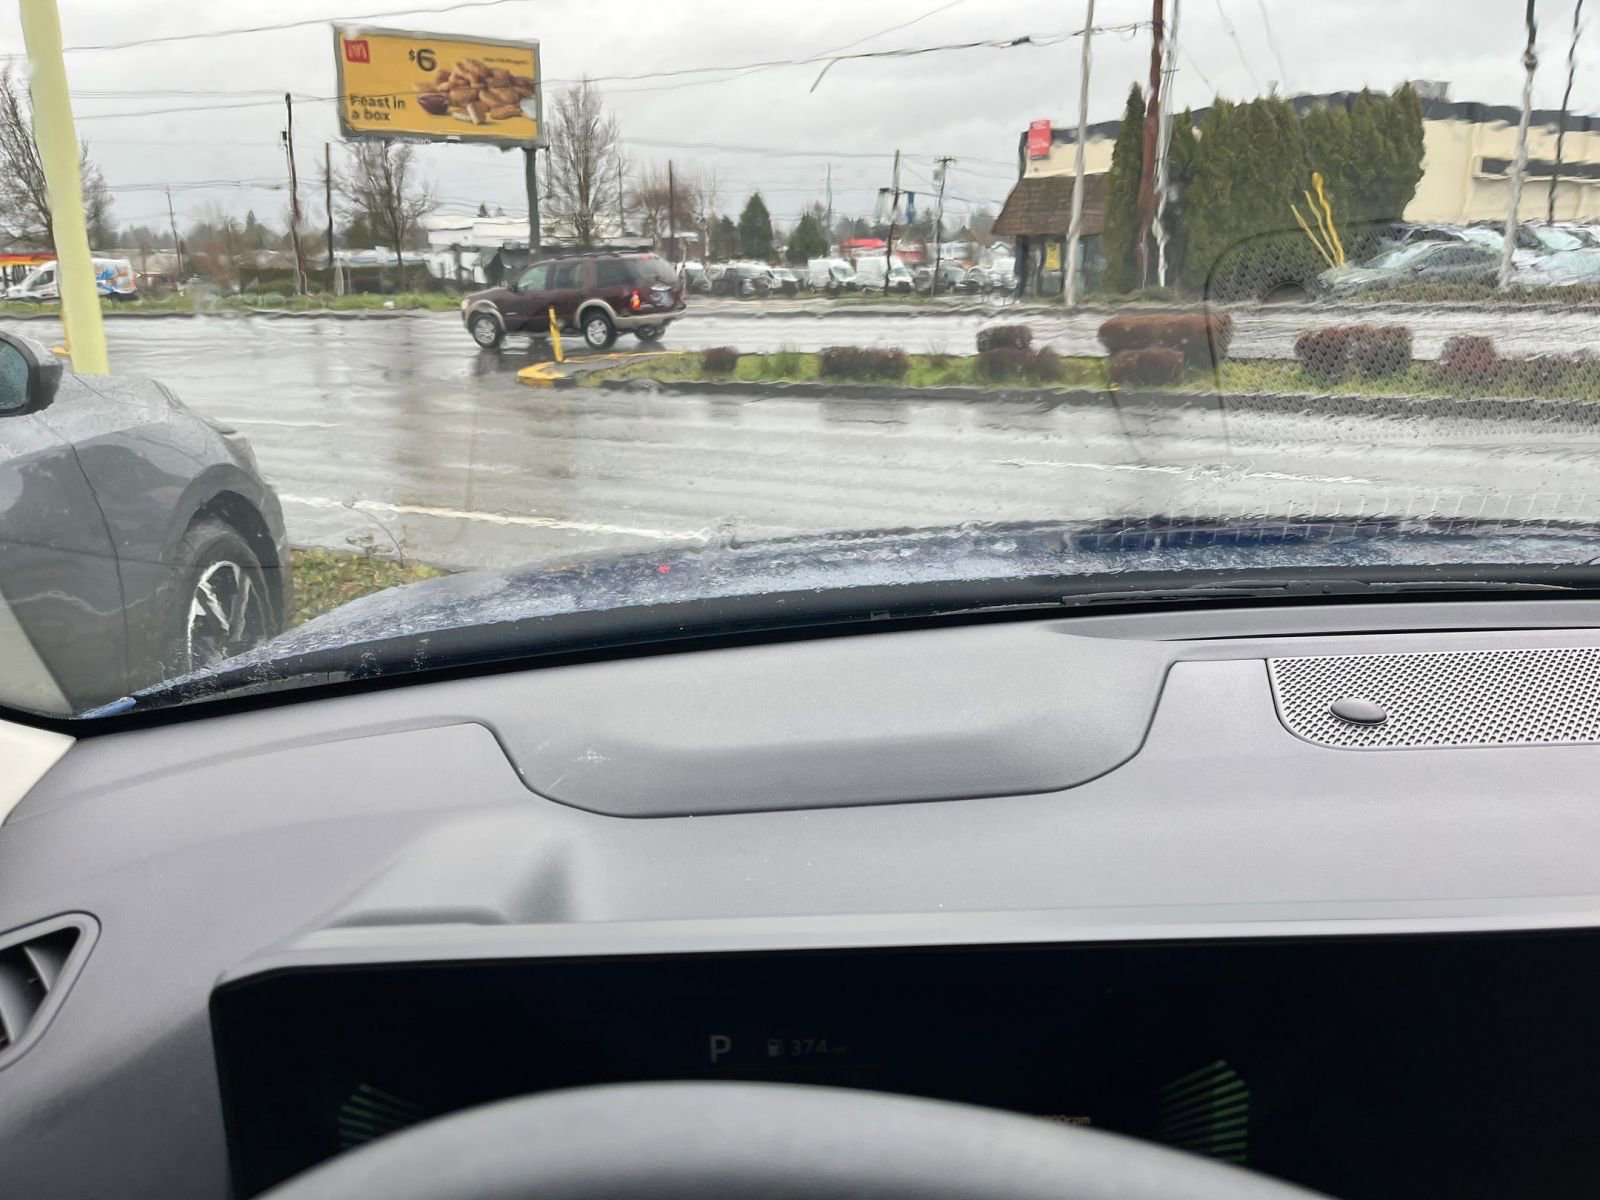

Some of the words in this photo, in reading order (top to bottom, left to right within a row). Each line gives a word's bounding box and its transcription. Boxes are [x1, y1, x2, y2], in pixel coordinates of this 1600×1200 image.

[408, 48, 437, 72] $6
[350, 94, 391, 109] Feast
[393, 95, 406, 109] in
[351, 111, 360, 121] a
[364, 108, 390, 121] box
[709, 1034, 732, 1064] P
[790, 1039, 828, 1057] 374
